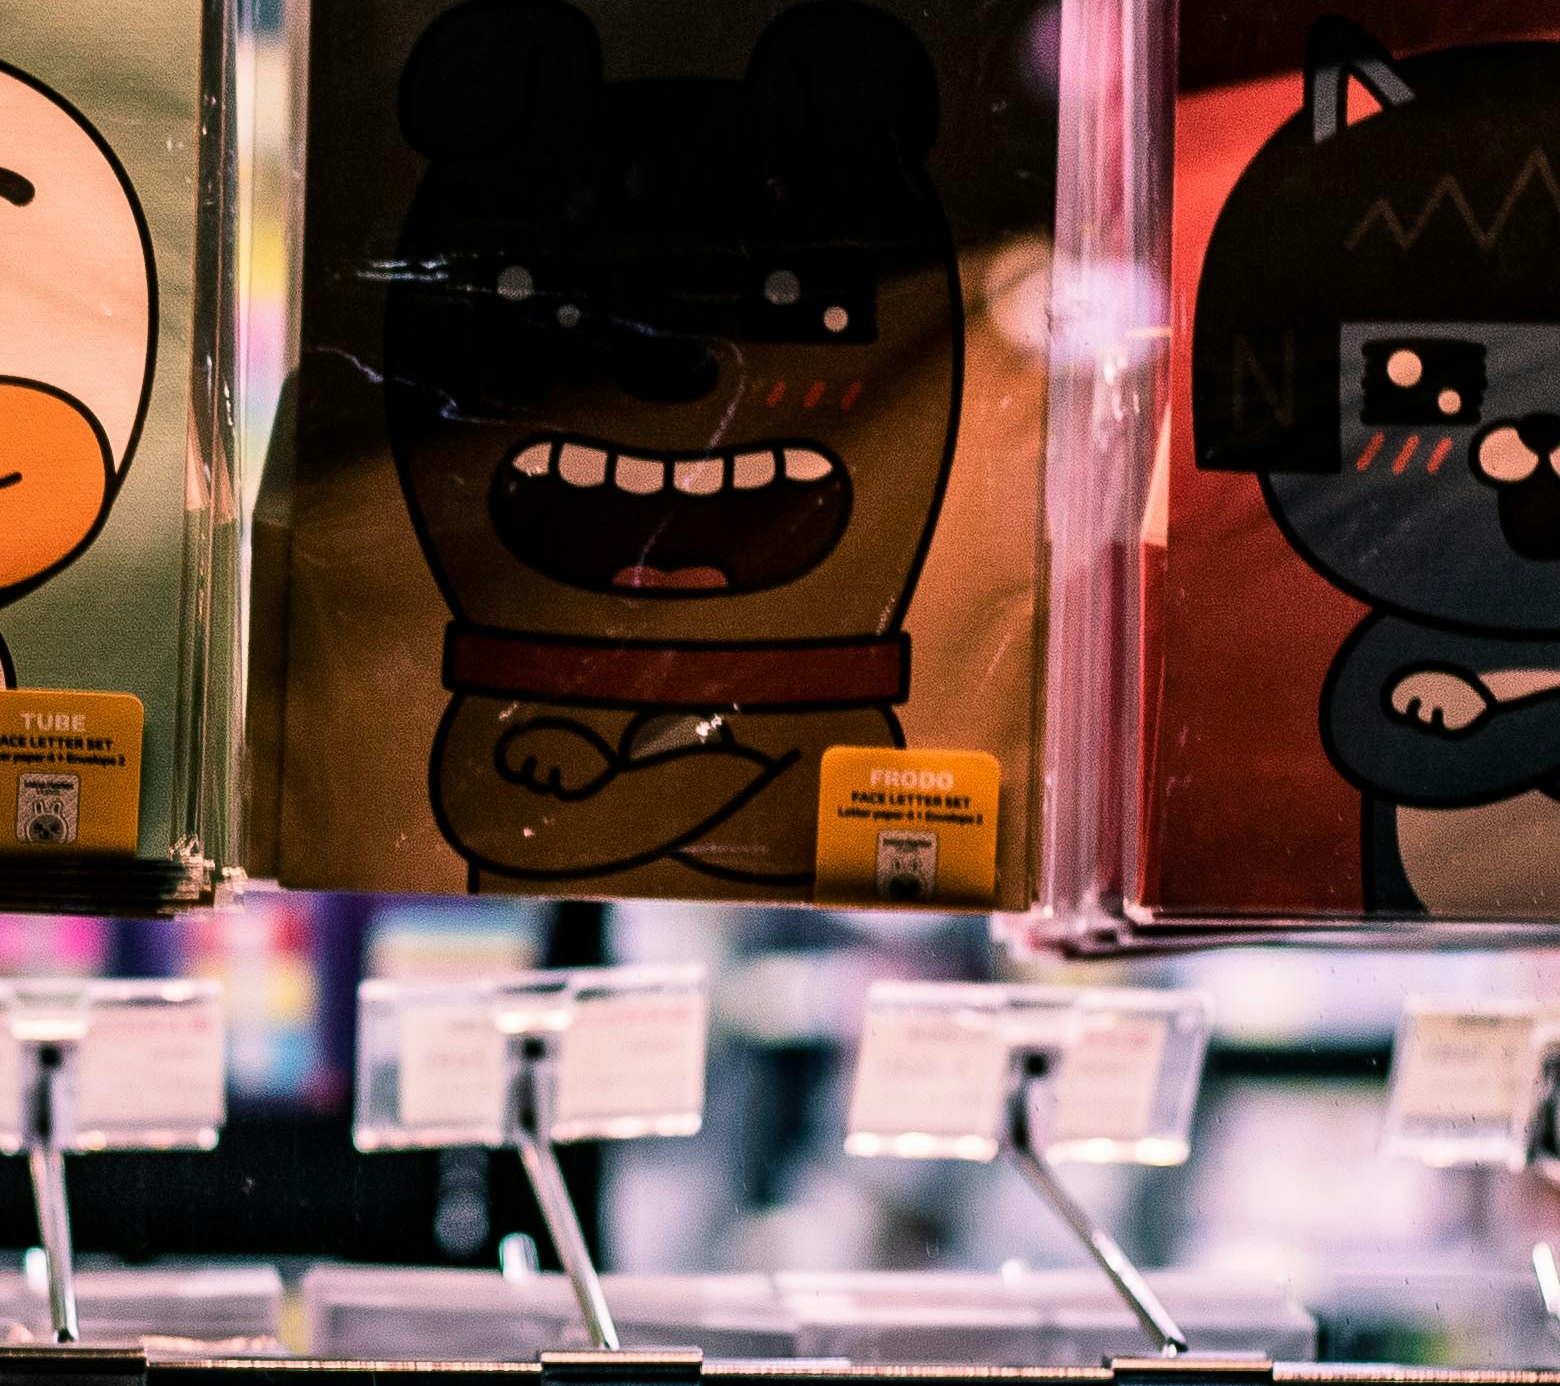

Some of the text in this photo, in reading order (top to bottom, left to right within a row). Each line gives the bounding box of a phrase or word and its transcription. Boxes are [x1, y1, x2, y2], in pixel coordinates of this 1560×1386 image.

[20, 712, 87, 733] TUBE
[30, 734, 84, 751] LETTER
[86, 737, 114, 752] SET
[870, 768, 955, 791] FRODO
